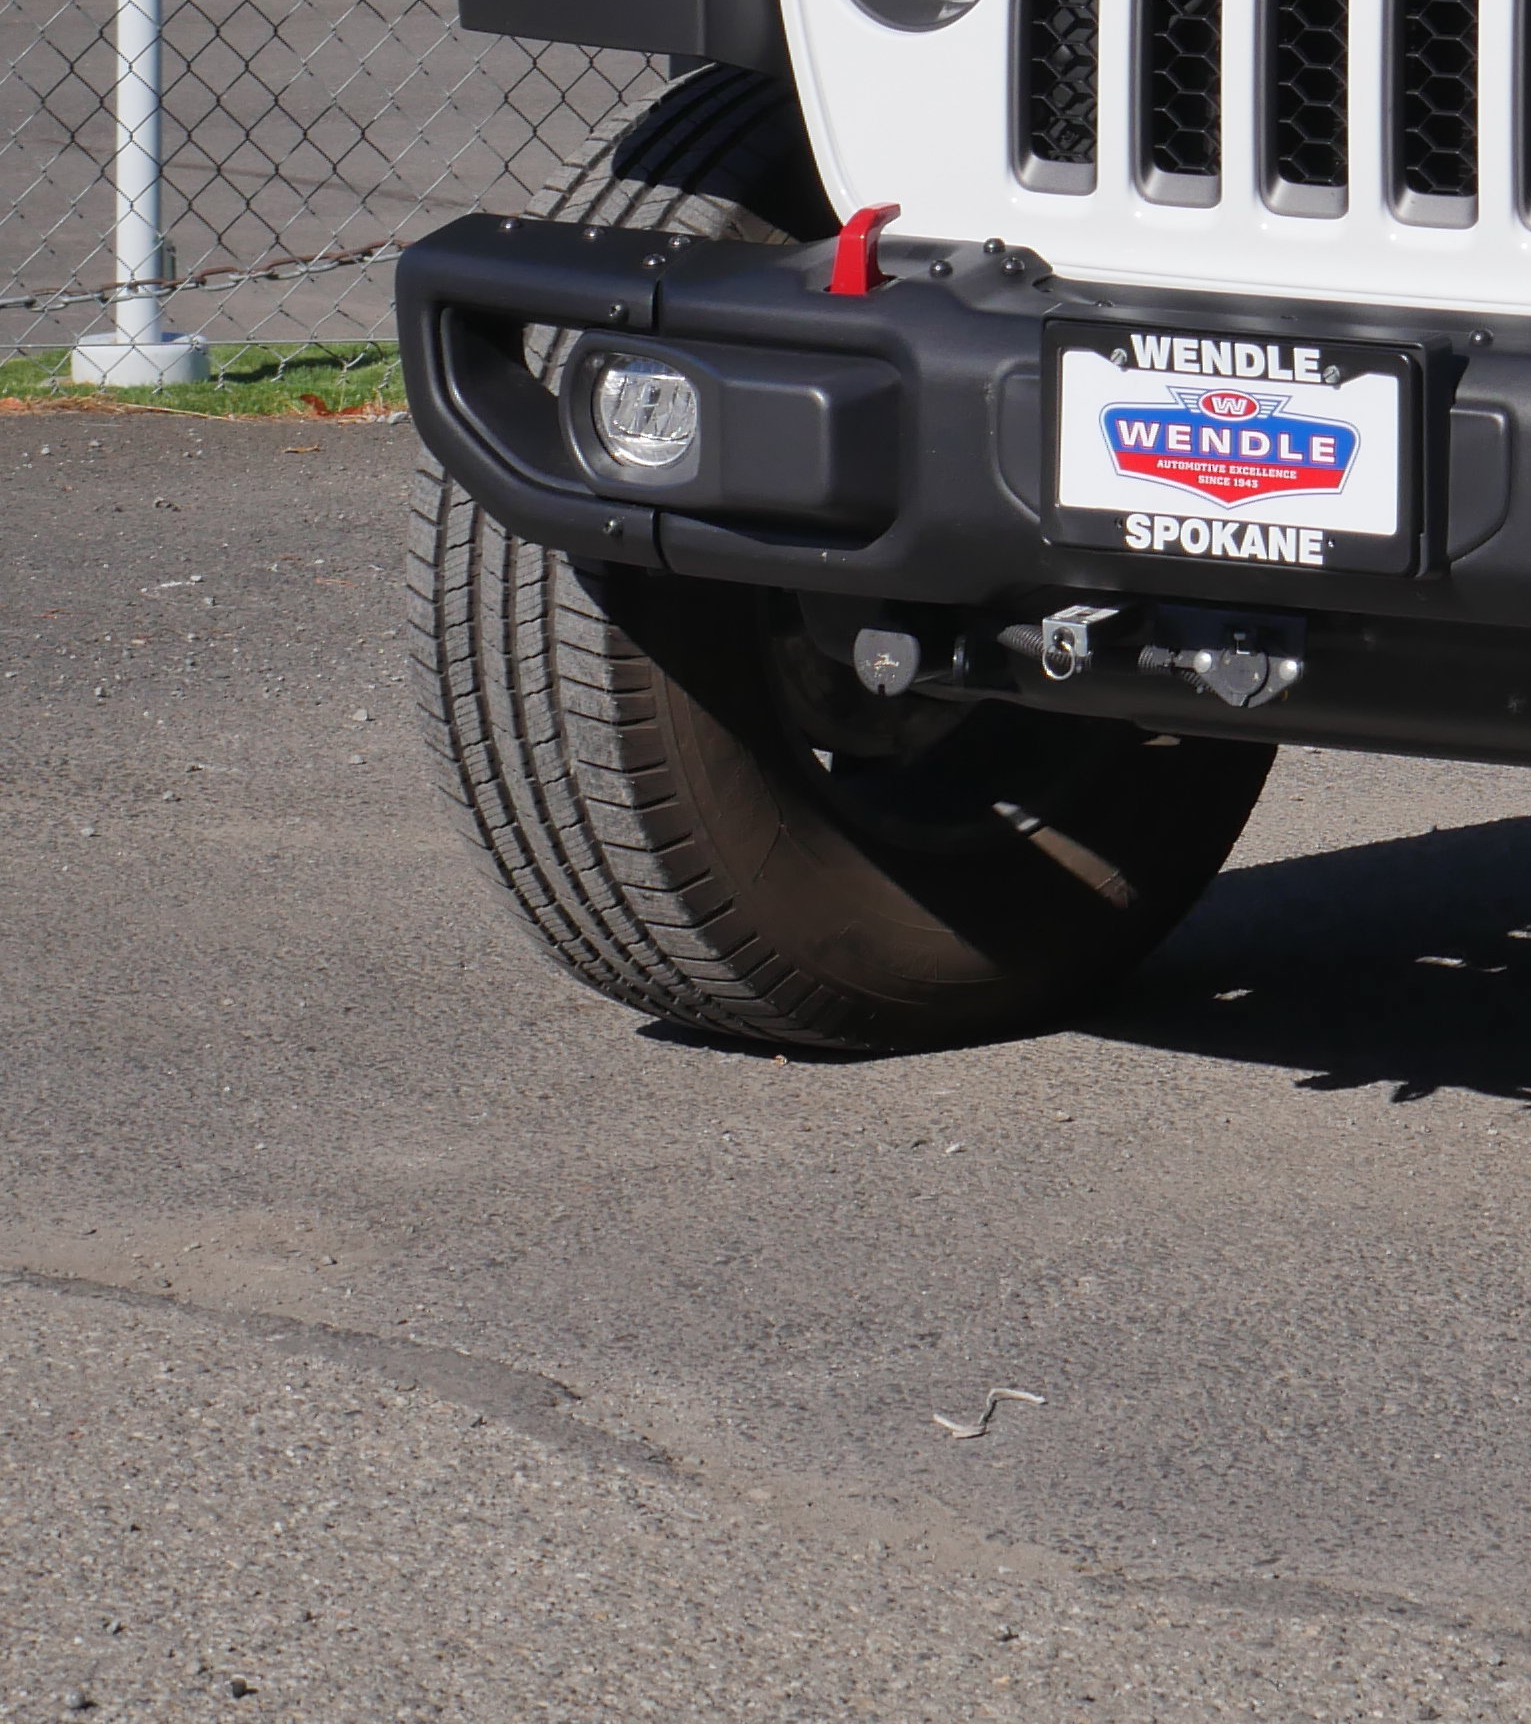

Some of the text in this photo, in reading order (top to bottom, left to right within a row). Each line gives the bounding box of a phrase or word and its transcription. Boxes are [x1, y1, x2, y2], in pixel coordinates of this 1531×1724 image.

[1130, 334, 1322, 383] WENDLE
[1116, 420, 1337, 464] WENDLE
[1156, 459, 1297, 480] AUTOMOTIVE EXCELLENCE
[1197, 475, 1259, 489] SINCE 1943
[1125, 513, 1325, 566] SPOKANE
